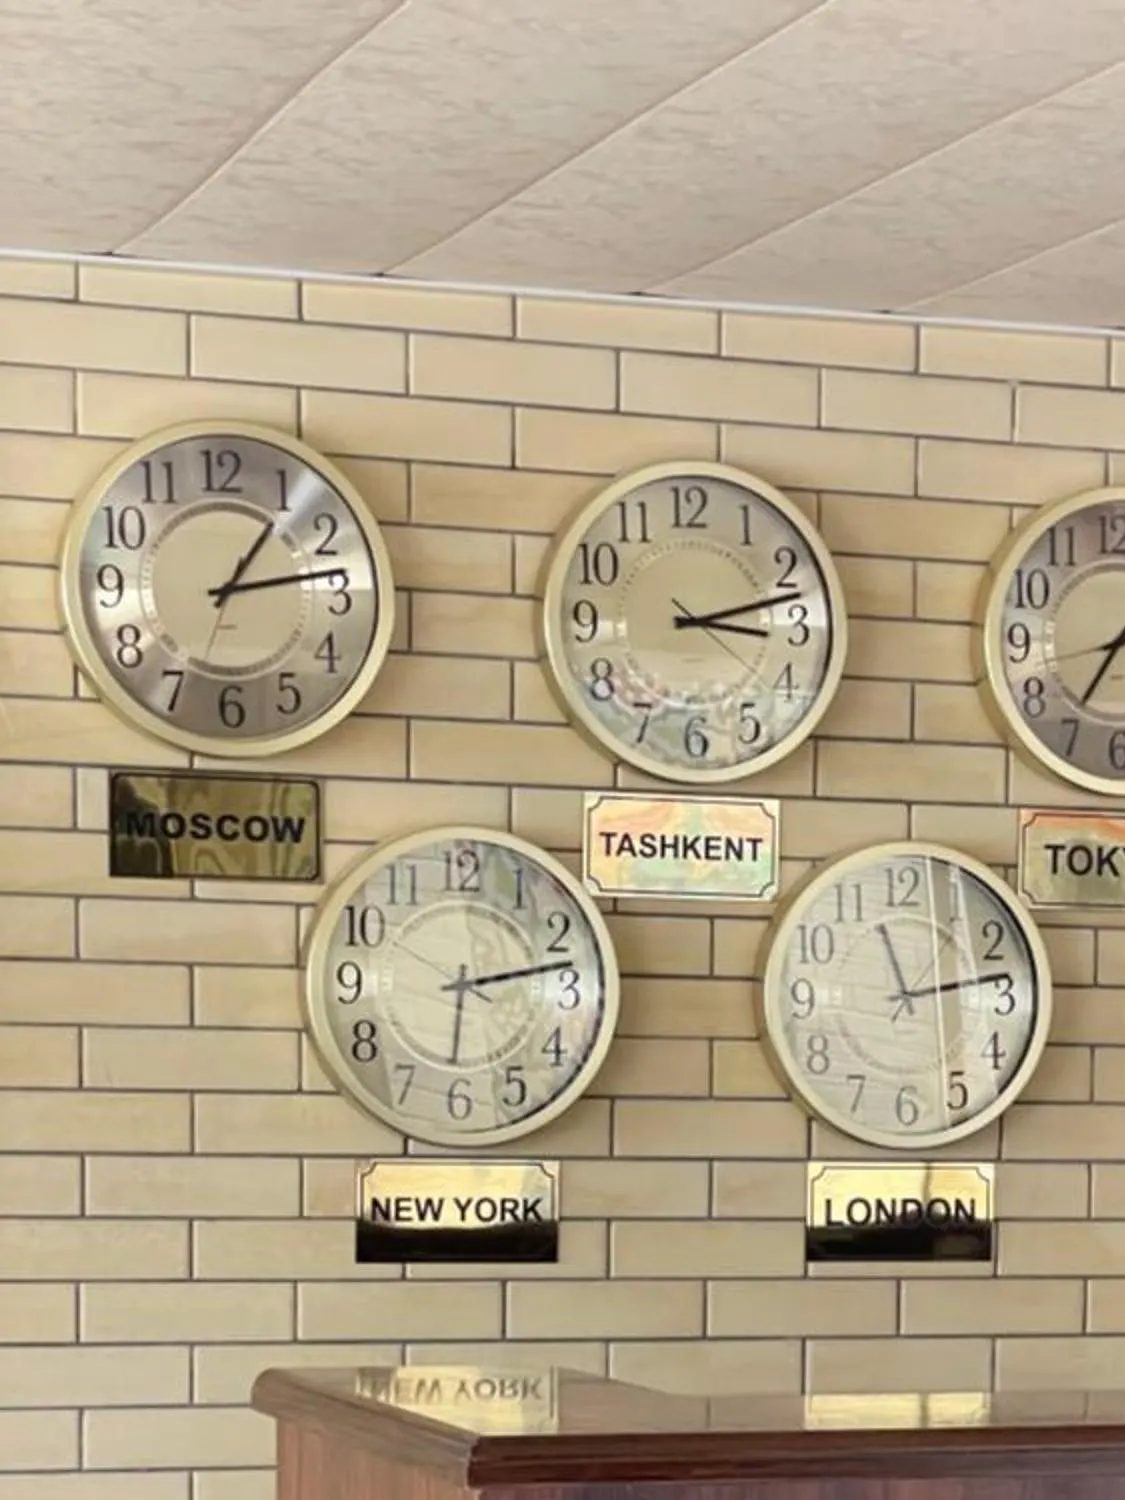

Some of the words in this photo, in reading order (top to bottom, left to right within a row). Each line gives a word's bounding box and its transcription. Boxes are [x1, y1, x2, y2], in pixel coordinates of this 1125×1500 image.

[141, 461, 177, 503] 11
[200, 449, 243, 493] 12
[277, 470, 292, 511] 1
[103, 506, 146, 550] 10
[618, 502, 652, 543] 11
[670, 486, 708, 529] 12
[739, 505, 753, 546] 1
[314, 513, 338, 556] 2
[1048, 527, 1077, 566] 11
[578, 543, 618, 585] 10
[774, 547, 798, 588] 2
[96, 564, 124, 608] 9
[328, 572, 352, 615] 3
[1015, 568, 1050, 609] 10
[573, 601, 598, 643] 9
[787, 605, 809, 647] 3
[116, 624, 143, 668] 8
[315, 632, 341, 673] 4
[1008, 623, 1030, 663] 9
[162, 670, 185, 712] 7
[276, 673, 301, 715] 5
[590, 658, 614, 701] 8
[774, 663, 799, 702] 4
[1023, 676, 1046, 717] 8
[219, 686, 245, 728] 6
[633, 702, 653, 744] 7
[739, 703, 761, 744] 5
[684, 716, 709, 758] 6
[1061, 718, 1079, 756] 7
[126, 811, 306, 843] MOSCOW
[600, 832, 763, 862] TASHKENT
[385, 864, 419, 906] 11
[442, 850, 480, 893] 12
[512, 868, 526, 910] 1
[884, 867, 920, 907] 12
[833, 884, 864, 923] 11
[345, 905, 386, 948] 10
[547, 912, 570, 953] 2
[797, 925, 834, 964] 10
[982, 920, 1004, 961] 2
[336, 961, 362, 1005] 9
[557, 969, 580, 1010] 3
[791, 978, 815, 1019] 9
[994, 975, 1015, 1016] 3
[352, 1020, 378, 1062] 8
[542, 1027, 568, 1067] 4
[807, 1034, 830, 1074] 8
[981, 1032, 1006, 1070] 4
[395, 1064, 416, 1105] 7
[448, 1078, 472, 1120] 6
[503, 1066, 526, 1106] 5
[846, 1075, 866, 1113] 7
[947, 1071, 967, 1110] 5
[896, 1086, 918, 1126] 6
[372, 1197, 444, 1222] NEW
[453, 1197, 543, 1223] YORK
[825, 1197, 975, 1227] LONDON
